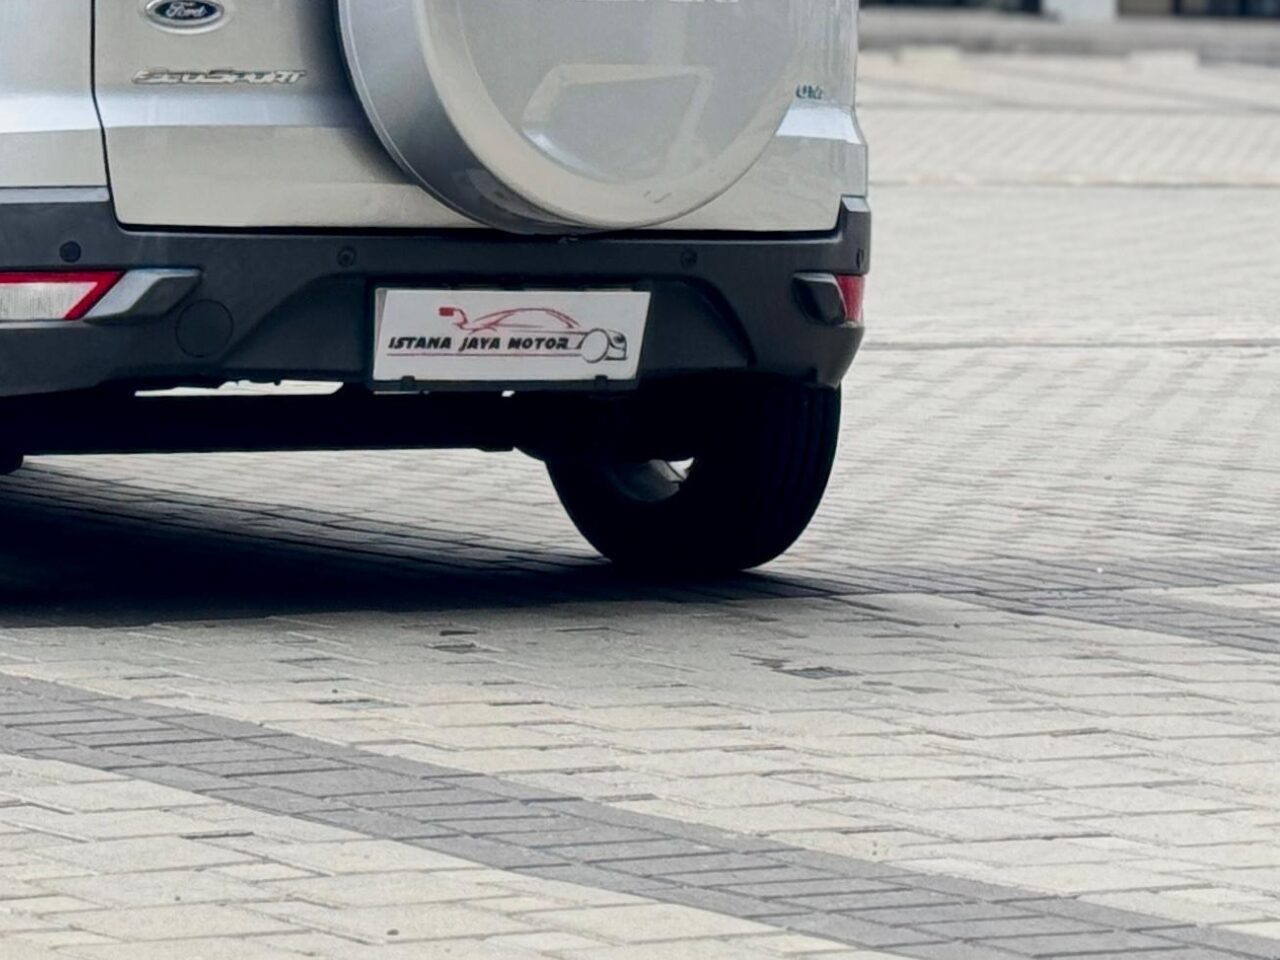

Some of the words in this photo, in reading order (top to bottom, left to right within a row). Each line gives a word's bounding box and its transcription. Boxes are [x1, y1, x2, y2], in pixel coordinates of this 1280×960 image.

[165, 1, 207, 18] Ford
[388, 336, 452, 350] ISTANA
[458, 336, 501, 352] JAYA
[507, 336, 569, 350] MOTOR
